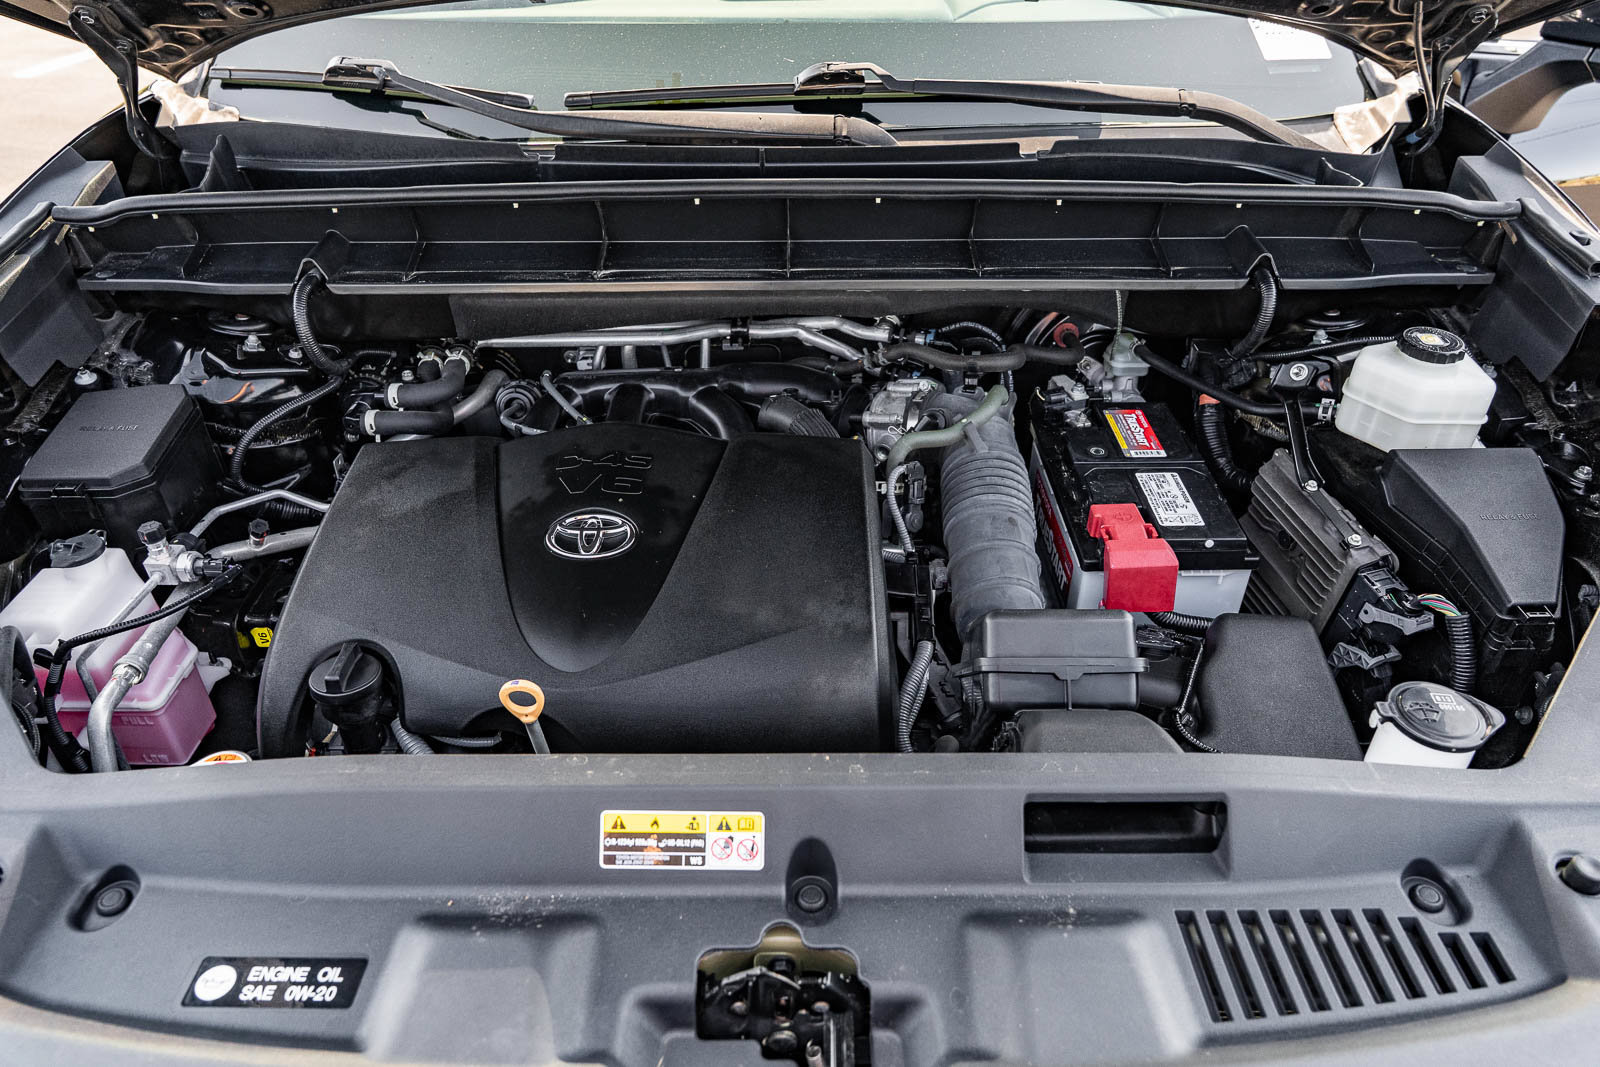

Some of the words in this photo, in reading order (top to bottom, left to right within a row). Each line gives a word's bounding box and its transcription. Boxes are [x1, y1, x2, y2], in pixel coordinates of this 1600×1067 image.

[558, 474, 643, 495] V6
[1479, 513, 1508, 521] RELAY
[1036, 492, 1068, 592] TRUESTART
[258, 632, 270, 644] V6
[120, 716, 155, 726] FULL
[142, 753, 170, 763] LOW
[247, 966, 311, 982] ENGINE
[316, 966, 344, 983] OIL
[238, 985, 277, 1001] SAE
[284, 985, 338, 1002] 0W-20
